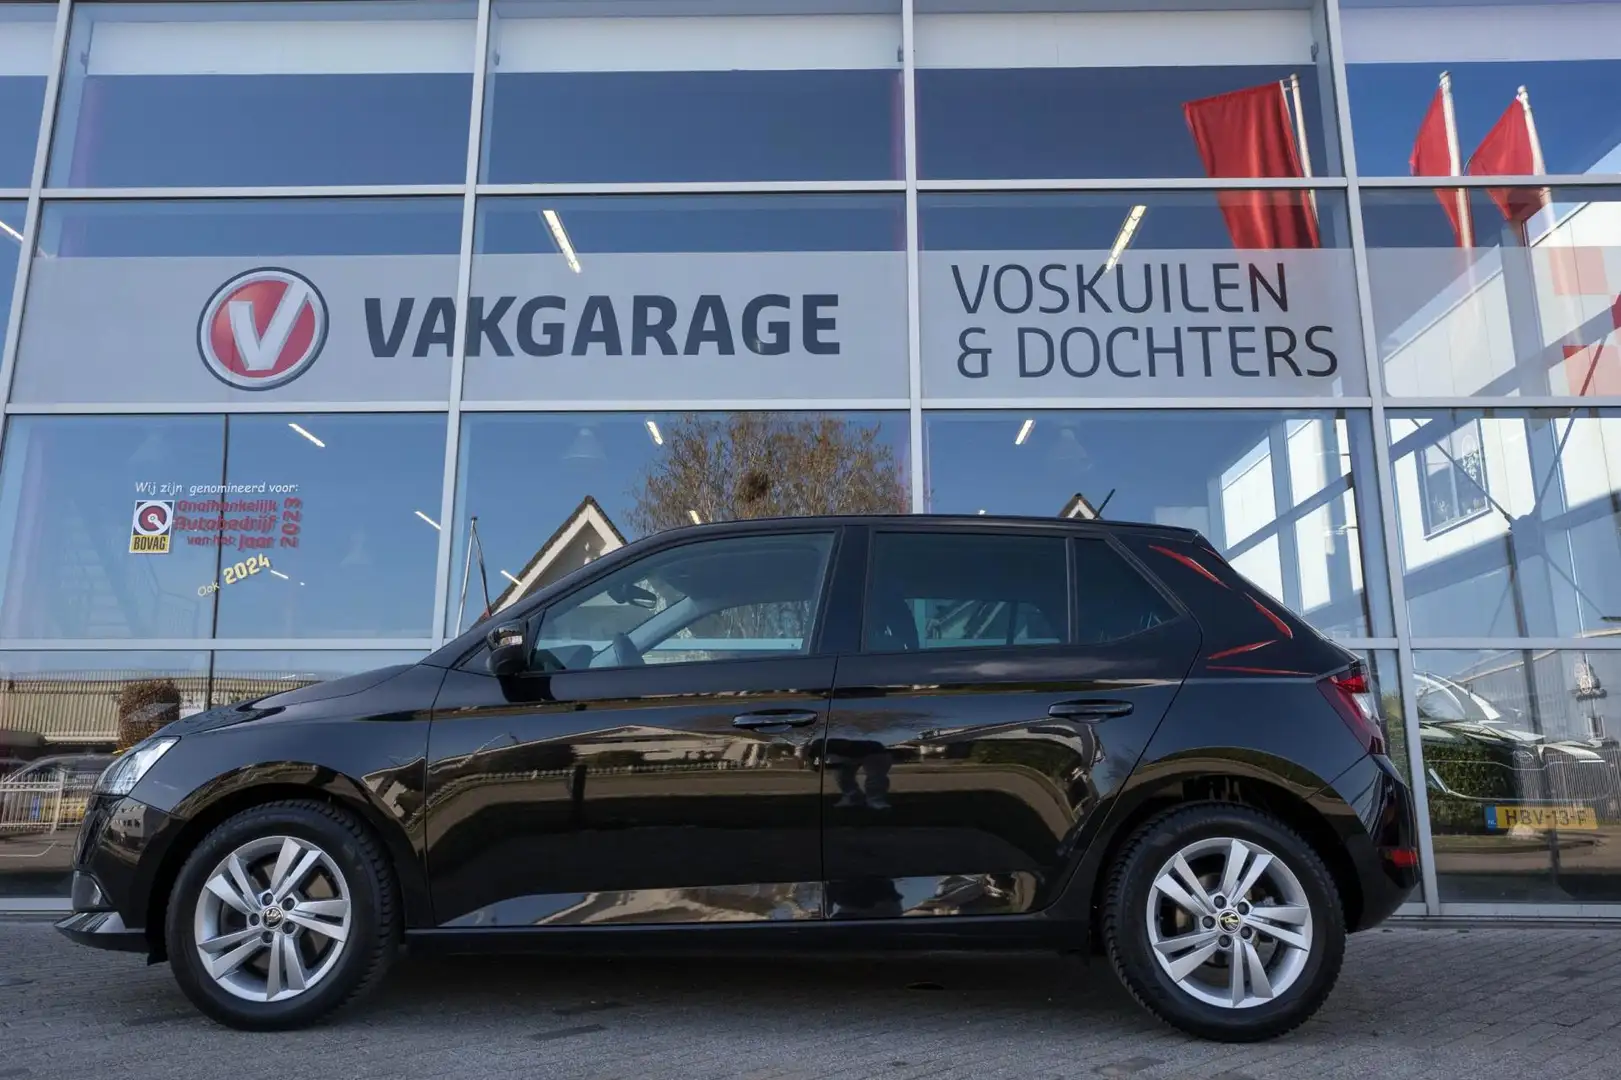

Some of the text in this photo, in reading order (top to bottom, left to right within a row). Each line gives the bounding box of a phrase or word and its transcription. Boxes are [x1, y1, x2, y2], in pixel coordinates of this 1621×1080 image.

[951, 263, 1289, 314] VOSKUILEN
[364, 294, 841, 357] VAKGARAGE
[957, 325, 1339, 378] & DOCHTERS
[135, 482, 299, 496] Wij zijn genomineerd voor:
[133, 536, 167, 551] BOVAG
[280, 497, 302, 548] 2023
[223, 553, 270, 585] 2024
